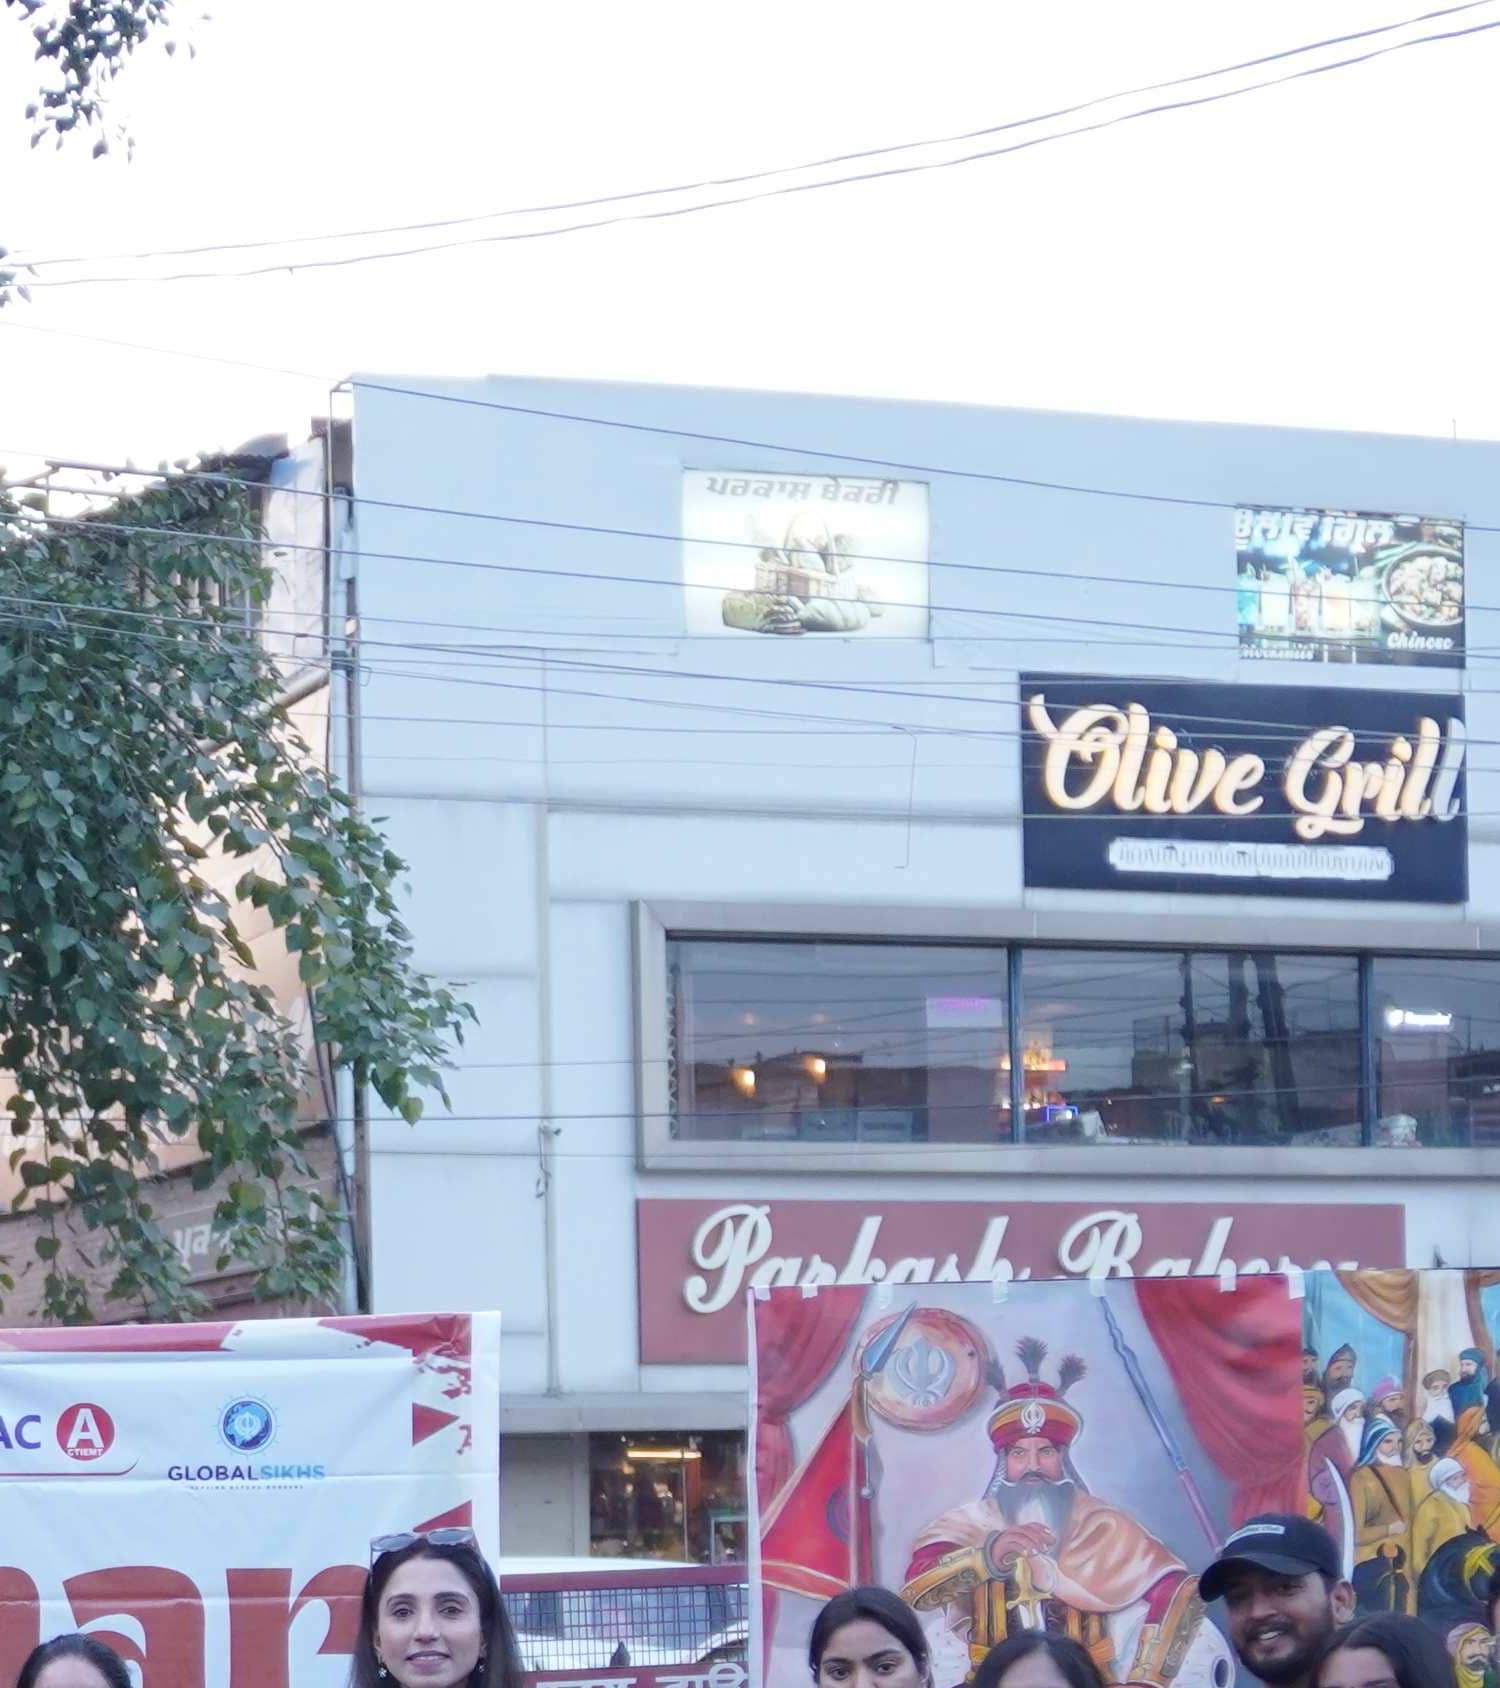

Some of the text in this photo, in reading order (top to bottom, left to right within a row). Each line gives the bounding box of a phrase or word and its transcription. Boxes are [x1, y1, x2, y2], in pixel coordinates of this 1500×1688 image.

[1029, 694, 1466, 840] Olive Grill
[66, 1407, 105, 1449] A
